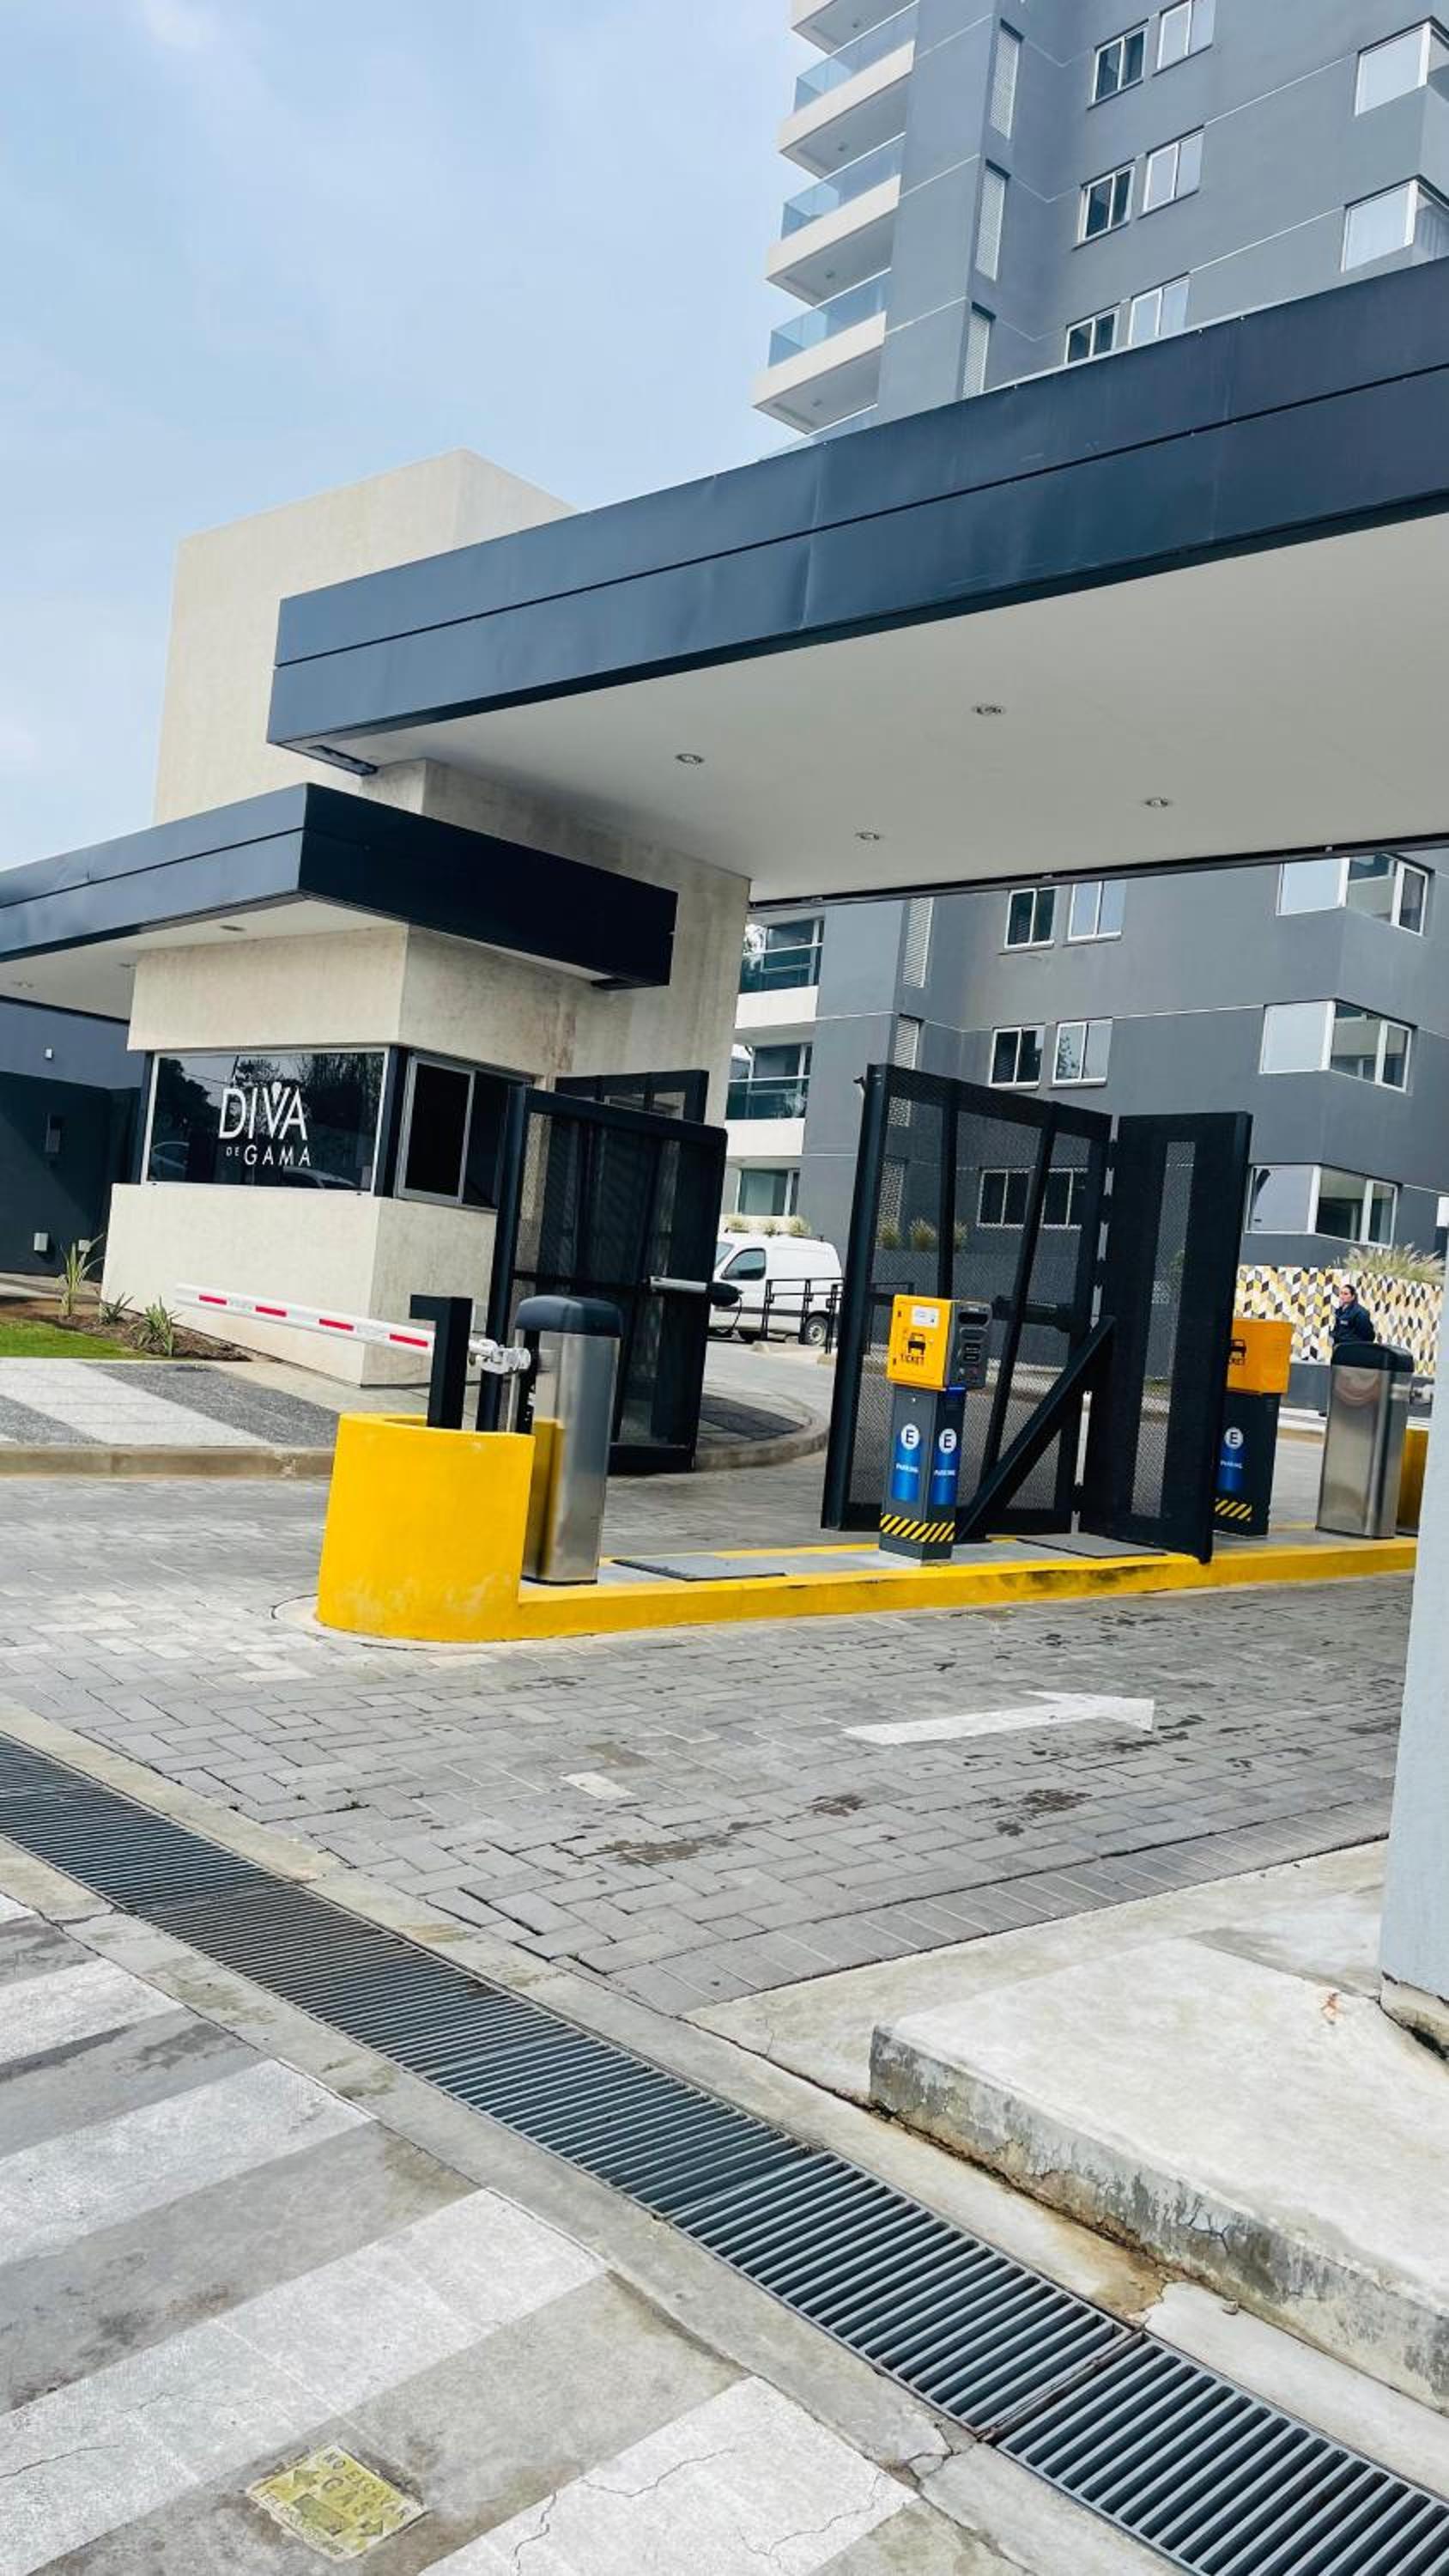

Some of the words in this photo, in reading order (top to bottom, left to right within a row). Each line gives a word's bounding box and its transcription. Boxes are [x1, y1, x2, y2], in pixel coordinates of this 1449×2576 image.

[219, 1085, 308, 1140] DIVA
[225, 1146, 240, 1157] DE
[244, 1144, 312, 1167] GAMA
[900, 1353, 925, 1366] TICKET
[906, 1429, 915, 1445] E
[943, 1433, 952, 1449] E
[1230, 1431, 1238, 1445] E
[323, 2451, 346, 2470] NO
[321, 2477, 374, 2517] GAS
